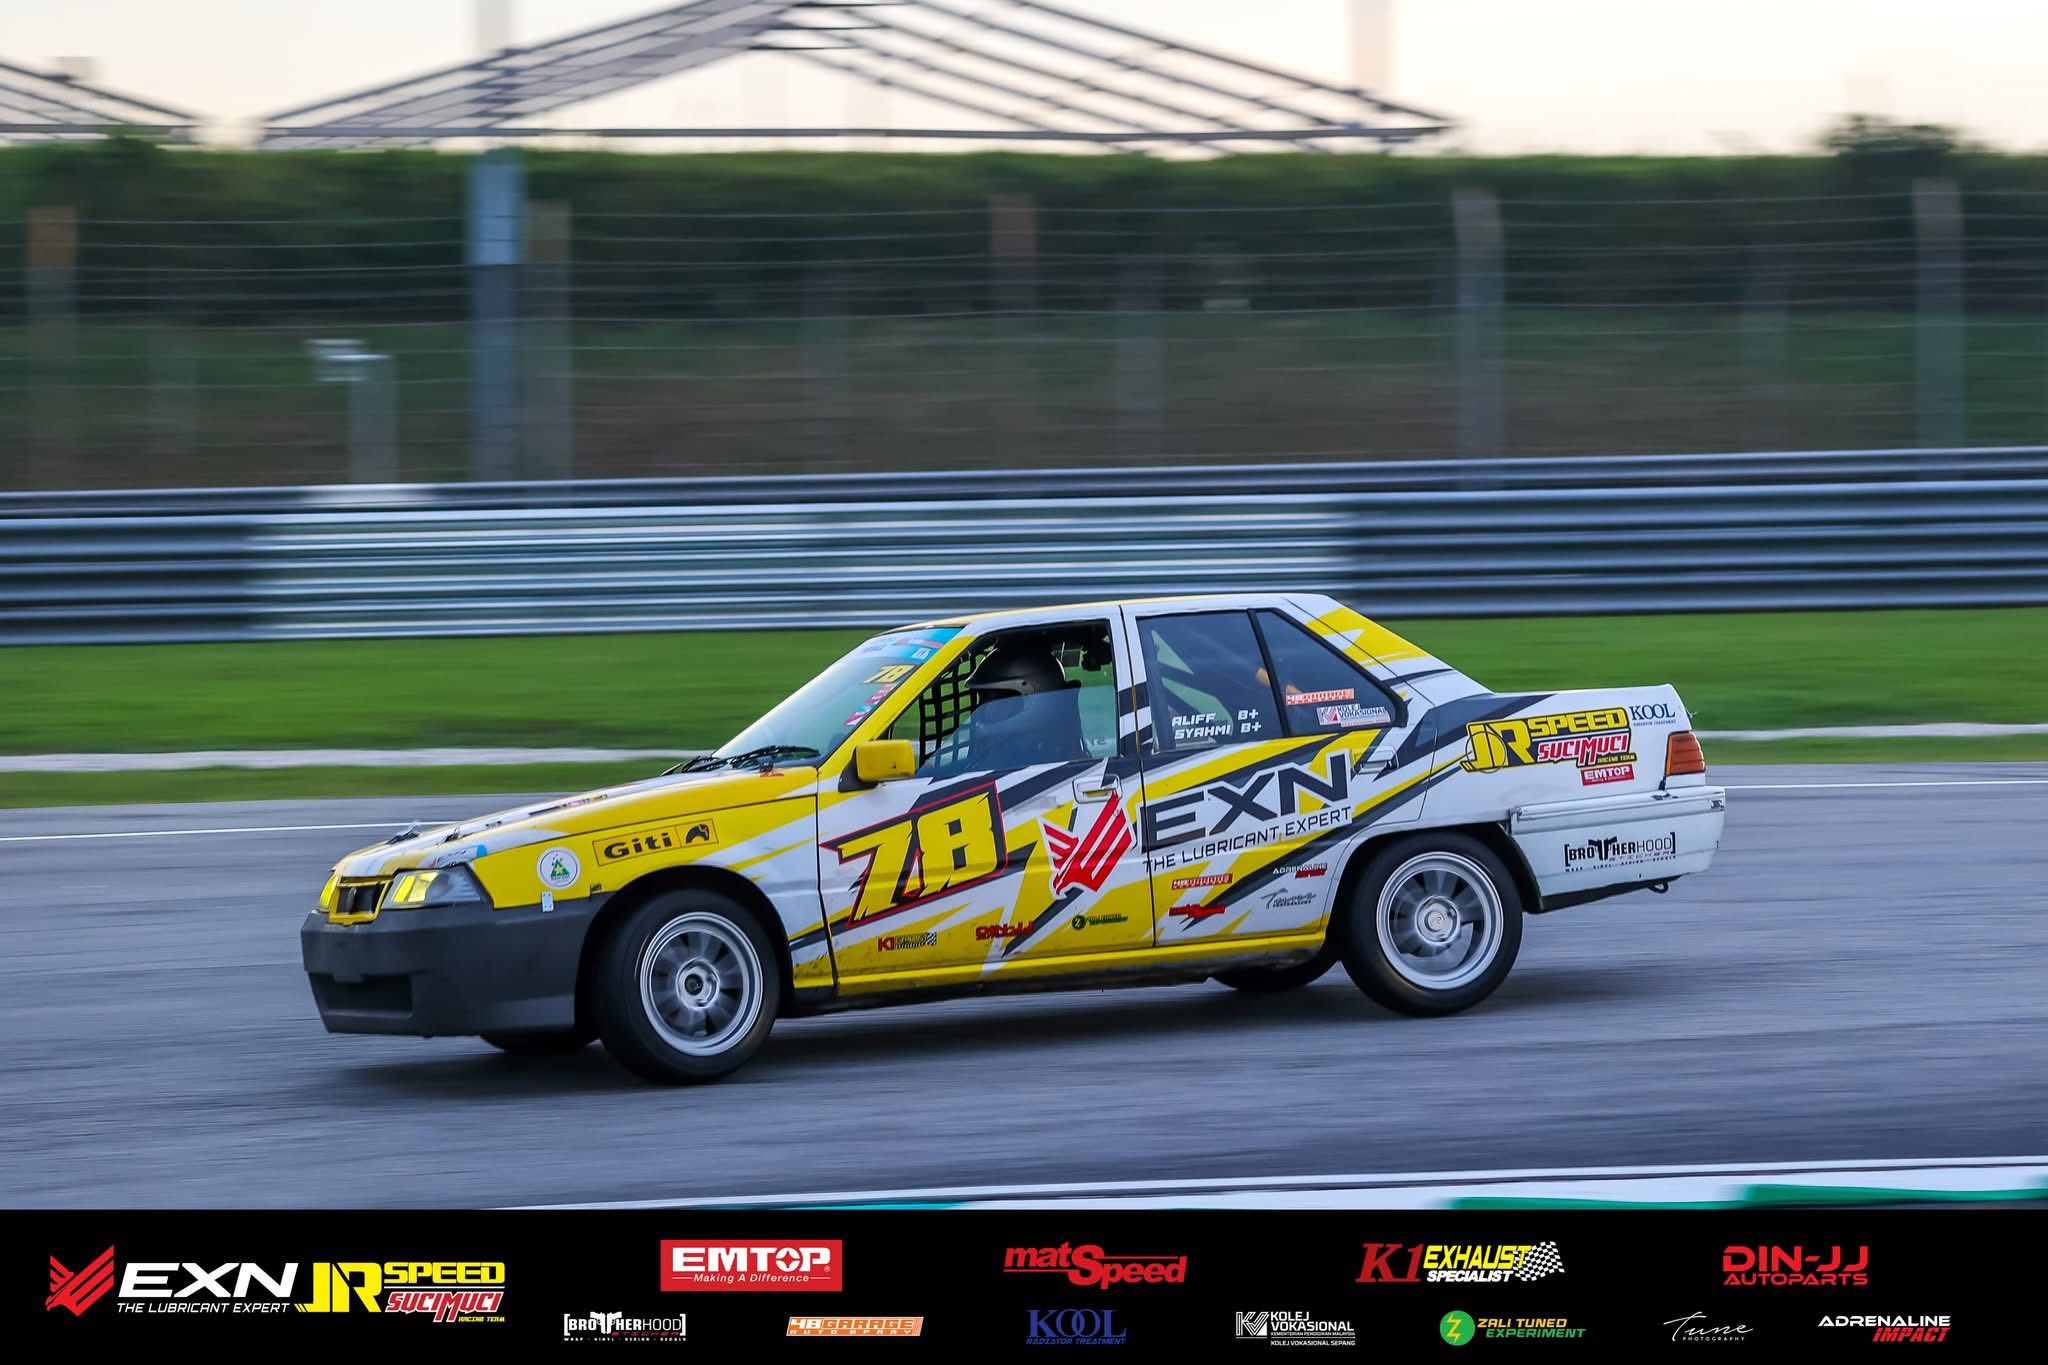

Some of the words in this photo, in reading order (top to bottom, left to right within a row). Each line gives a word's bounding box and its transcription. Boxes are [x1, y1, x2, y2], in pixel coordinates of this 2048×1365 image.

[864, 664, 916, 685] 78
[1172, 712, 1216, 727] ALIFF
[1238, 709, 1259, 720] B+
[1528, 708, 1628, 737] SPEED
[1629, 703, 1676, 720] KOOL
[1174, 724, 1231, 740] SYAHMI
[1241, 721, 1262, 733] B+
[1536, 732, 1630, 767] SUCIMUCI
[1583, 765, 1630, 780] EMTOP
[1139, 753, 1348, 854] EXN
[603, 832, 672, 859] Giti
[1142, 853, 1176, 873] THE
[1182, 825, 1281, 862] LUBRICANT
[1285, 806, 1351, 836] EXPERT
[837, 791, 998, 921] 78
